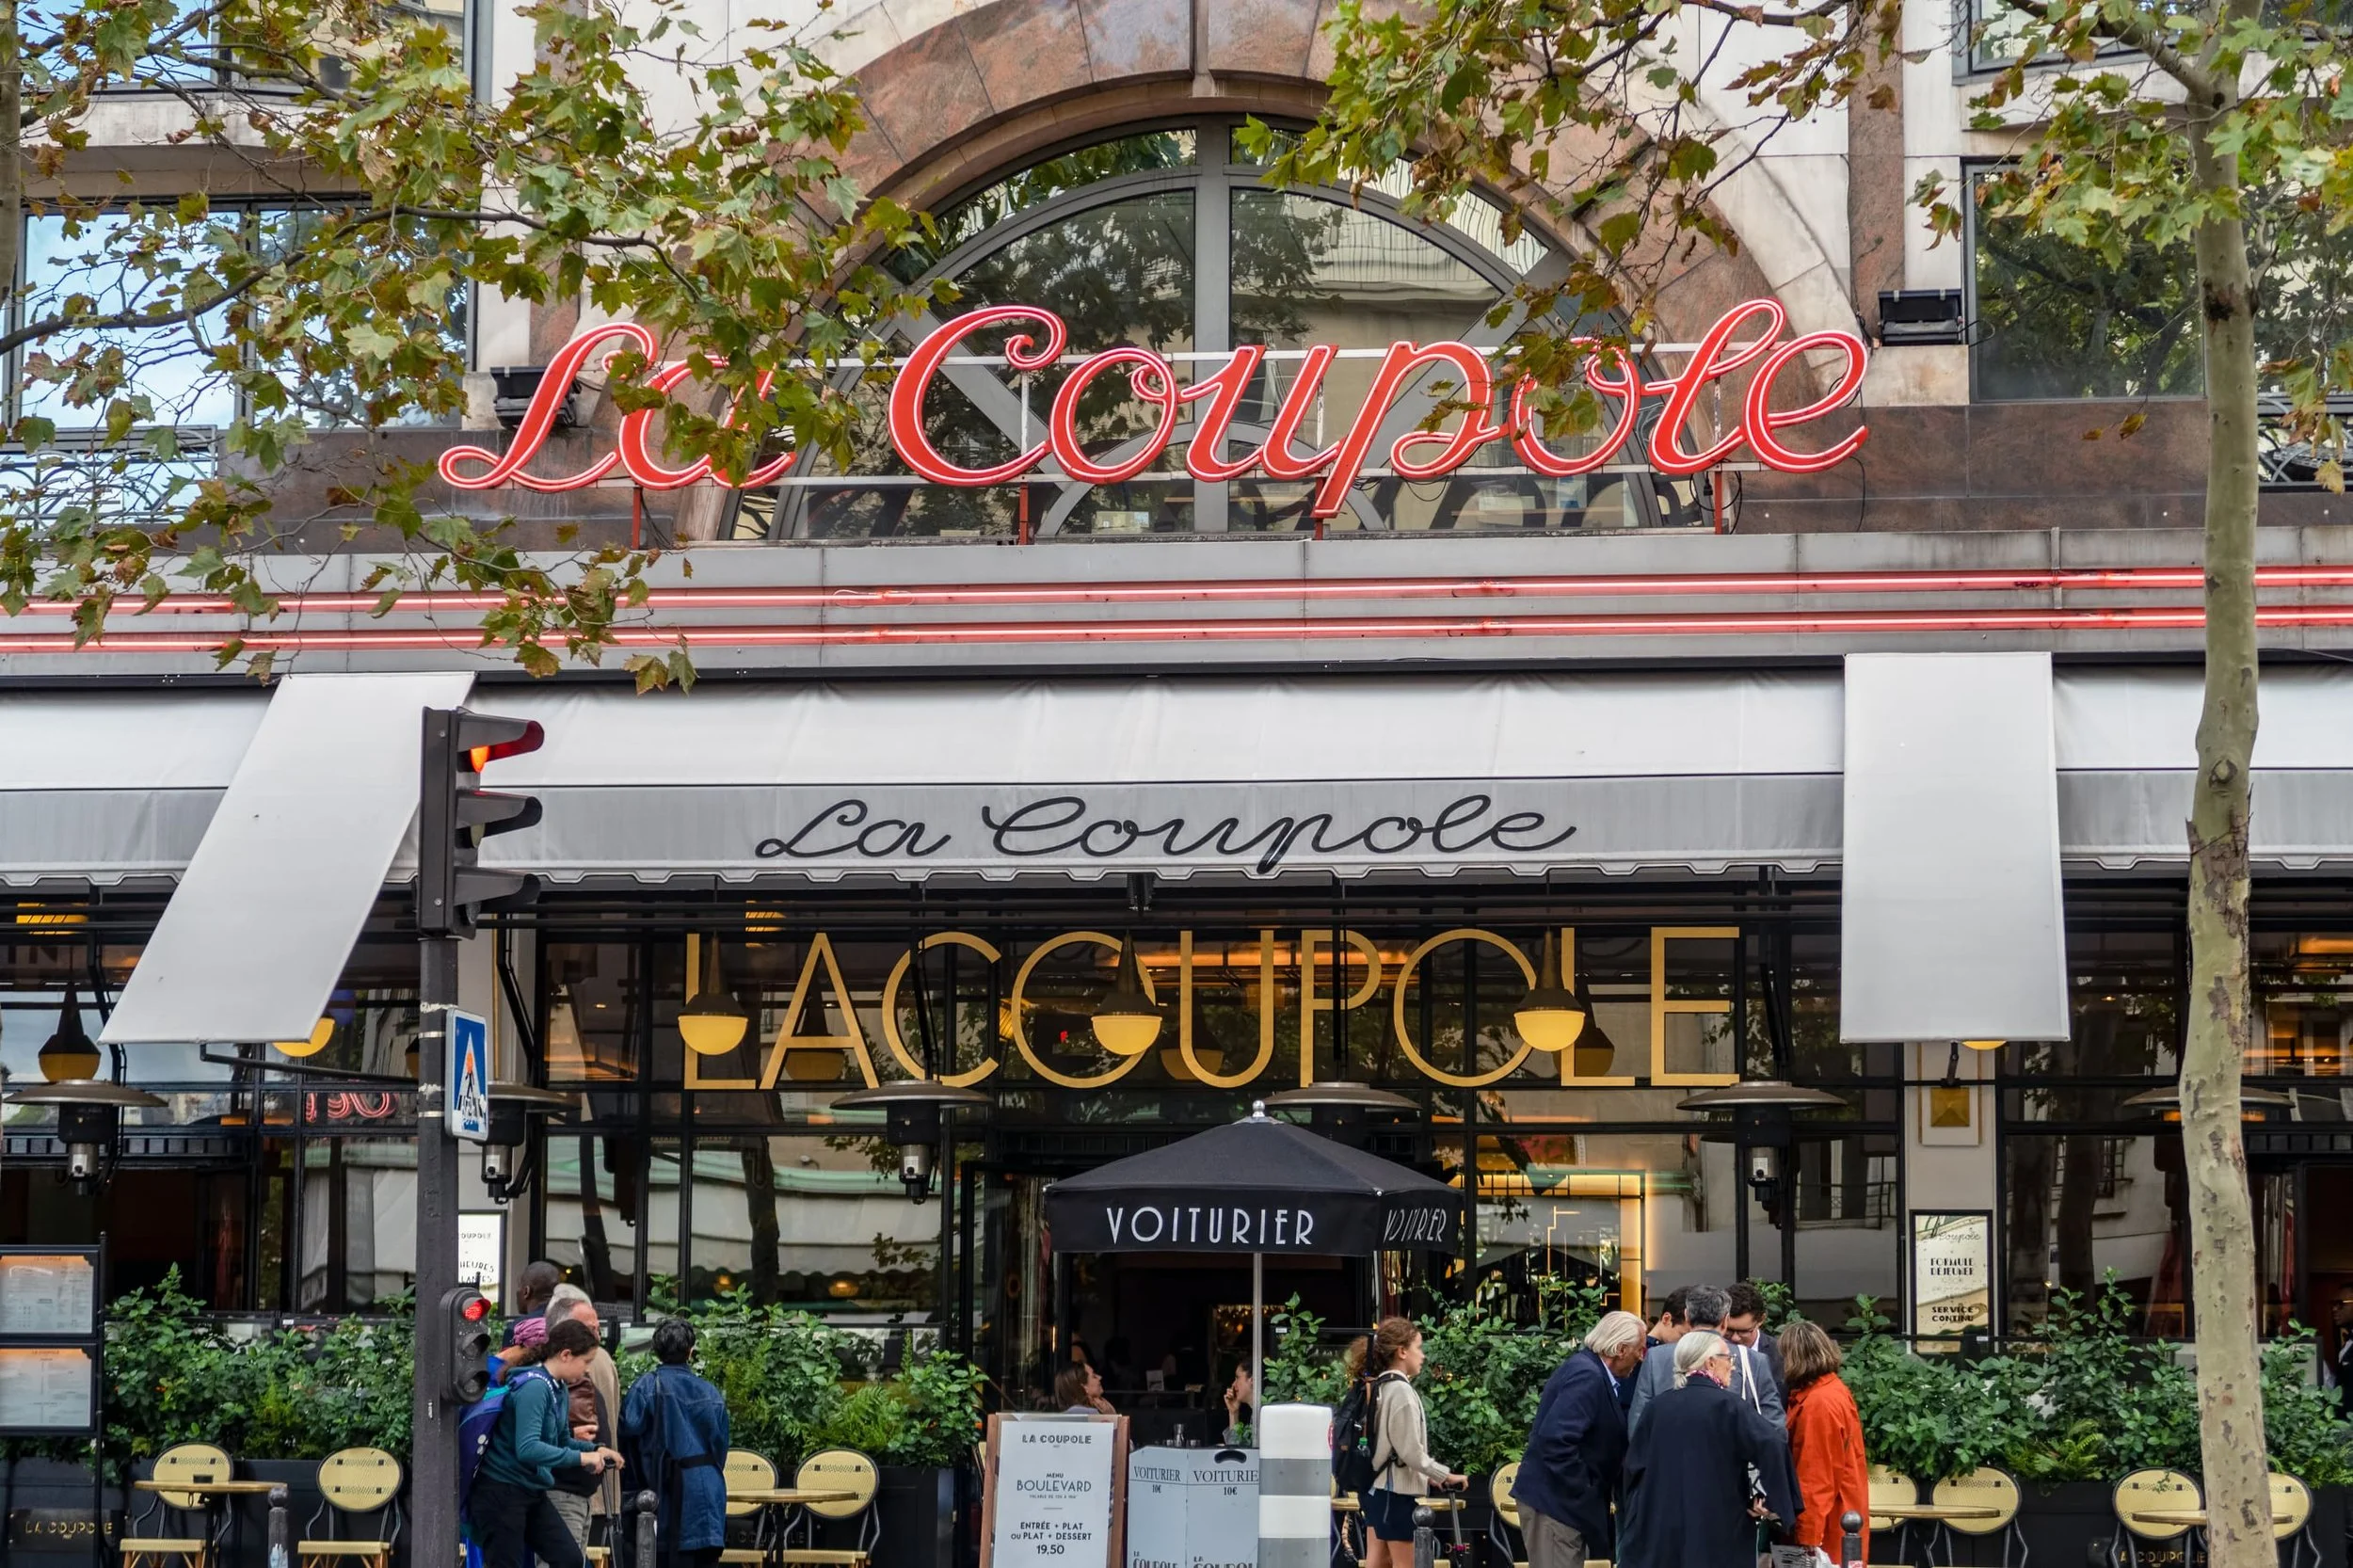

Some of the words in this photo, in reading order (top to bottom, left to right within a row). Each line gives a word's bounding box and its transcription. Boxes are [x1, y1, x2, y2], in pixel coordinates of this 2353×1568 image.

[439, 321, 796, 490] La
[888, 296, 1869, 519] Coupole
[755, 798, 952, 859] La
[982, 793, 1578, 874] Coupole
[1106, 1206, 1315, 1245] VOITURIER
[1382, 1208, 1448, 1243] VOIURIER
[1021, 1434, 1037, 1444] LA
[1039, 1434, 1093, 1445] COUPOLE
[1133, 1465, 1182, 1482] VOITURIER
[1193, 1469, 1259, 1483] VOITURIE
[1016, 1480, 1092, 1493] BOULEVARD
[1152, 1484, 1162, 1494] 10€
[1224, 1486, 1238, 1496] 10€
[25, 1521, 43, 1534] LA
[47, 1521, 113, 1534] COUPOE
[1019, 1521, 1051, 1530] ENTRÉE
[1062, 1522, 1084, 1530] PLAT
[1023, 1532, 1044, 1541] PLAT
[1055, 1532, 1093, 1541] DESSERT
[1036, 1544, 1065, 1556] 19,50
